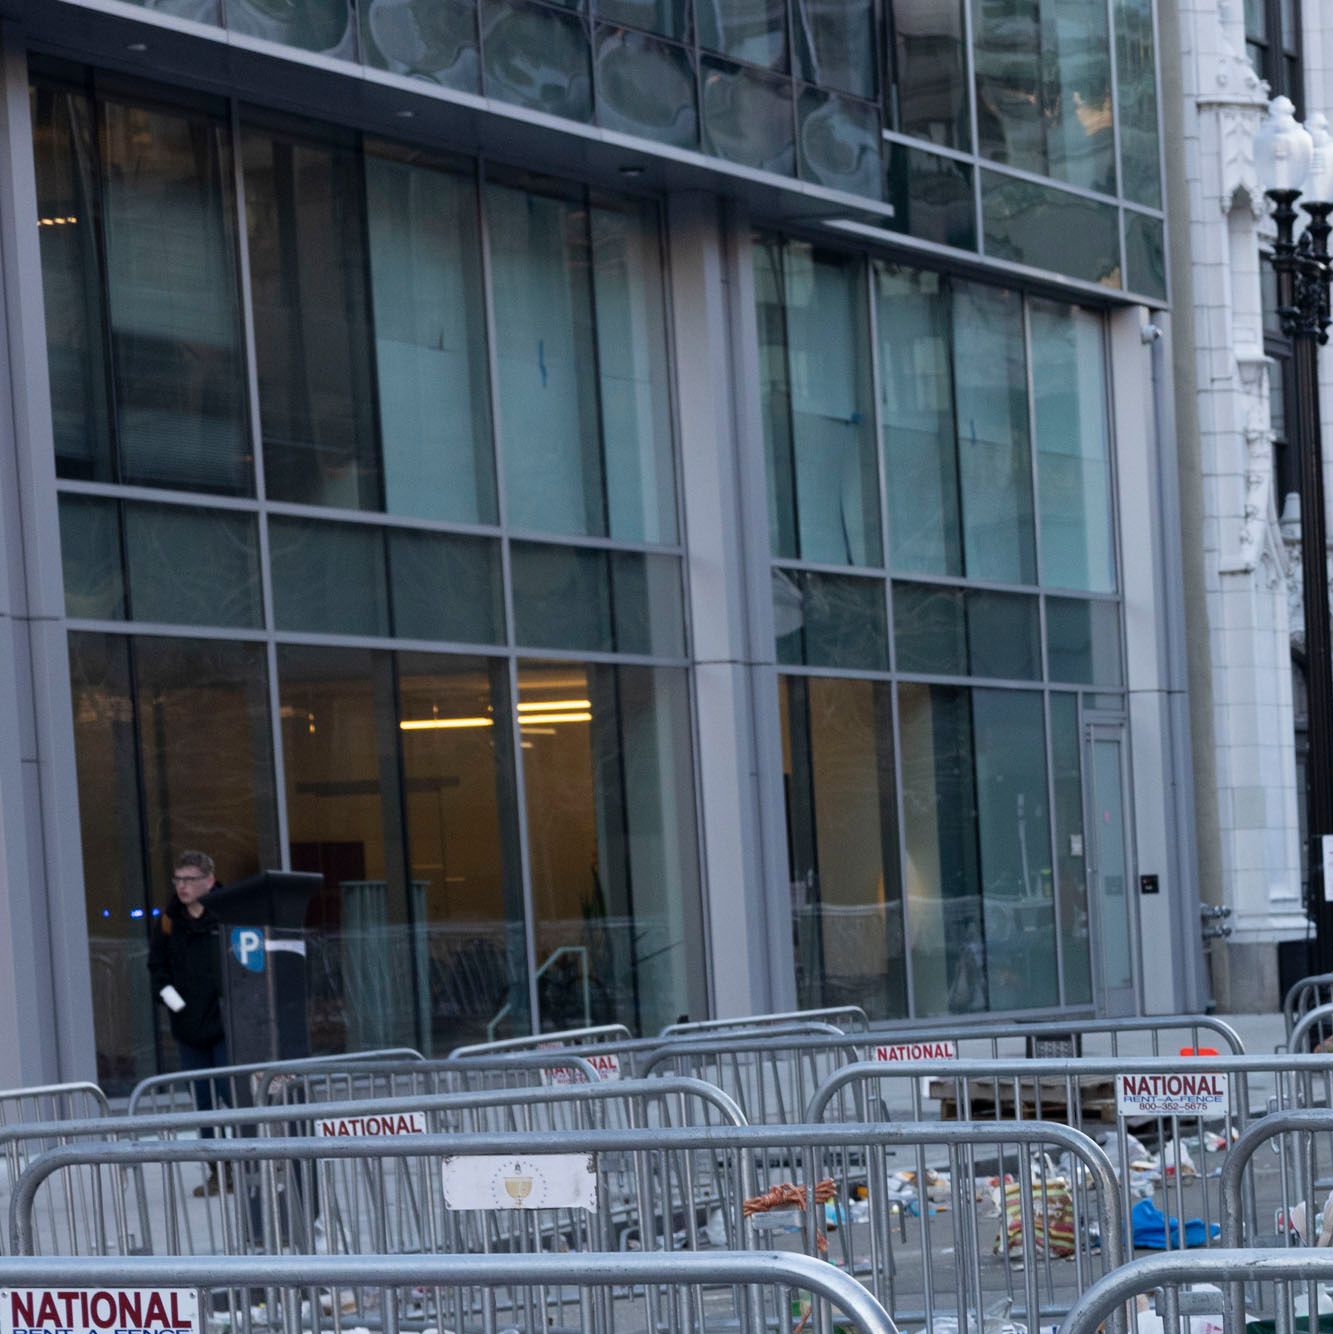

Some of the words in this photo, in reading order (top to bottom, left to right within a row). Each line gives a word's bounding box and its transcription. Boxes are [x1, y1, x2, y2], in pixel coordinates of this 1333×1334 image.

[240, 931, 260, 966] P
[877, 1043, 954, 1061] NATIONAL
[1122, 1075, 1225, 1096] NATIONAL
[1138, 1102, 1208, 1111] 800-352-5675
[322, 1114, 424, 1137] NATIONAL
[10, 1290, 192, 1329] NATIONAL
